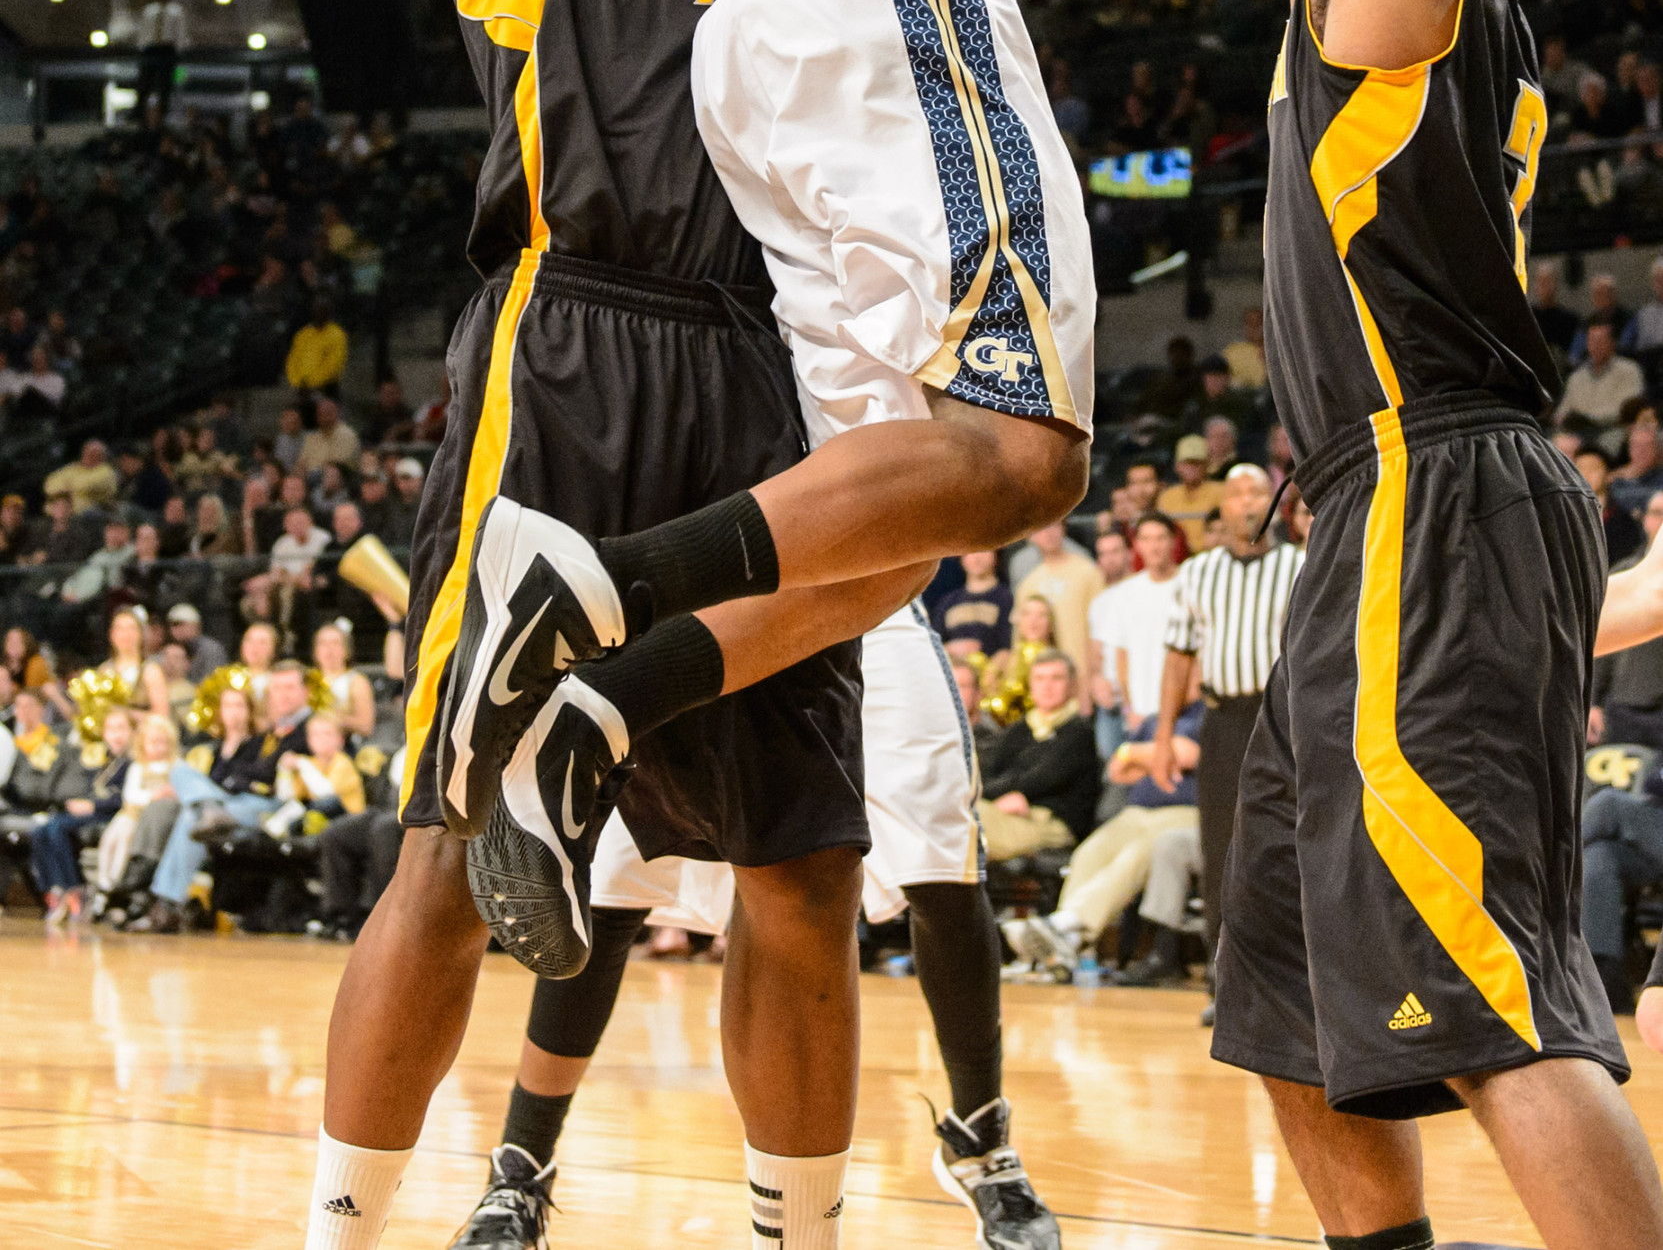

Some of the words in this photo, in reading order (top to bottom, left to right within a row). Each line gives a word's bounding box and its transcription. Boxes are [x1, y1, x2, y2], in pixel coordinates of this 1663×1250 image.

[964, 336, 1033, 382] GT
[1388, 1012, 1432, 1030] adidas
[322, 1202, 362, 1217] adidas
